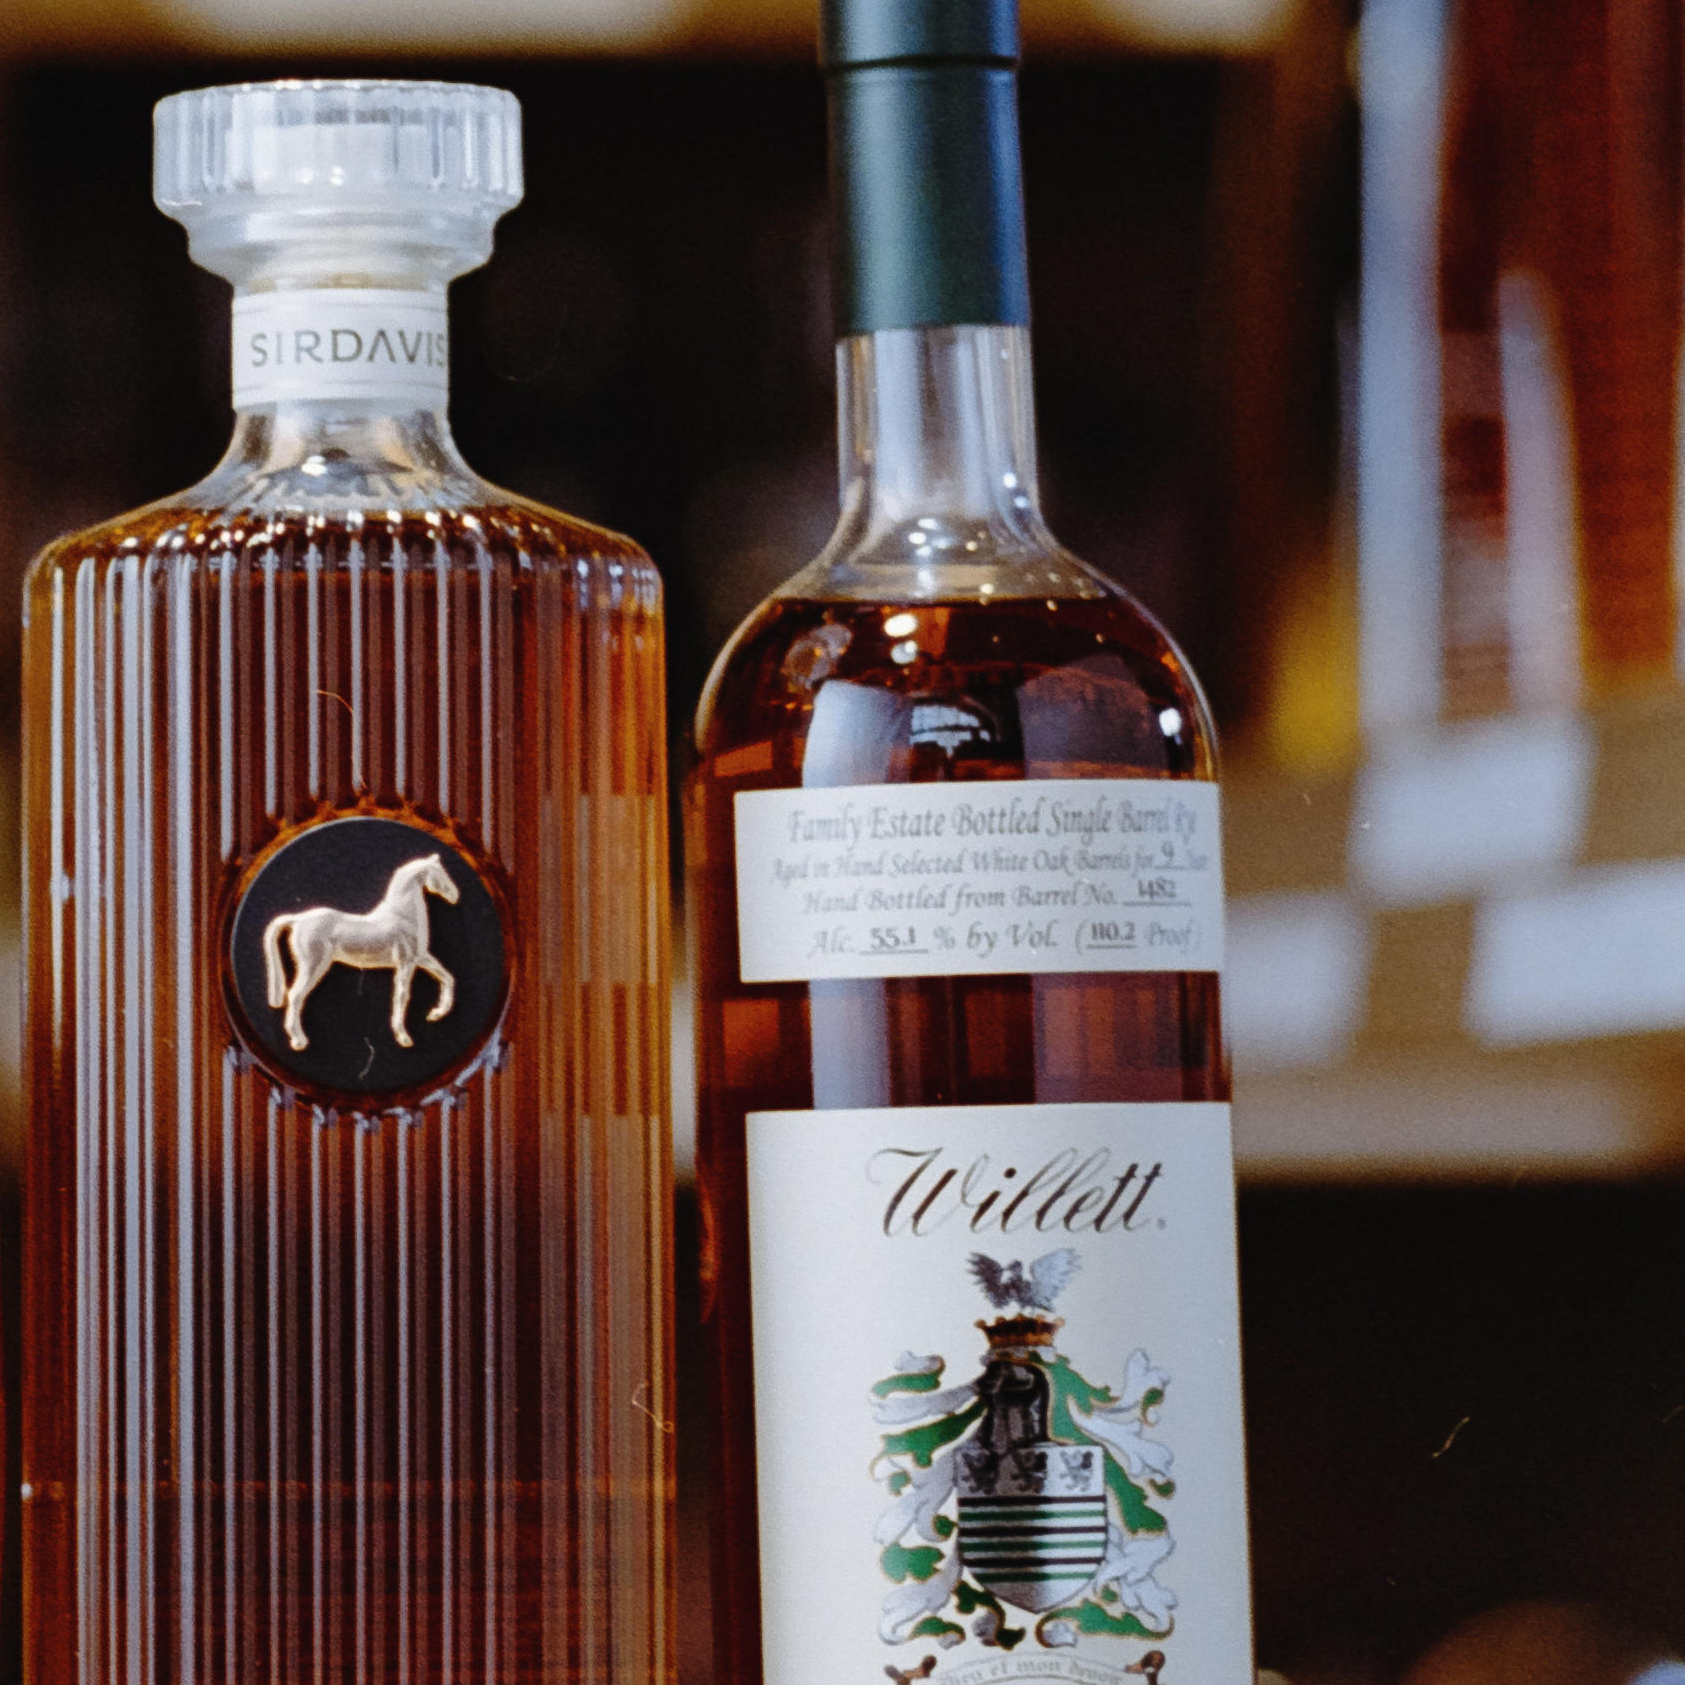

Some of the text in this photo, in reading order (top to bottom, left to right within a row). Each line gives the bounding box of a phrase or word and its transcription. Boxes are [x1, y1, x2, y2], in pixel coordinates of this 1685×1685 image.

[788, 801, 861, 853] Family
[870, 806, 946, 840] Estate
[951, 796, 1045, 837] Bottled
[1046, 795, 1112, 846] Single
[836, 851, 886, 878] Hand
[889, 848, 969, 878] Selected
[971, 847, 1029, 874] White
[1032, 845, 1075, 877] Oak
[804, 886, 862, 913] Hand
[867, 884, 953, 912] Bottled
[948, 883, 1005, 916] from
[1011, 881, 1082, 907] Barrel
[932, 926, 956, 950] %
[966, 921, 999, 959] by
[864, 1146, 1167, 1238] Willett
